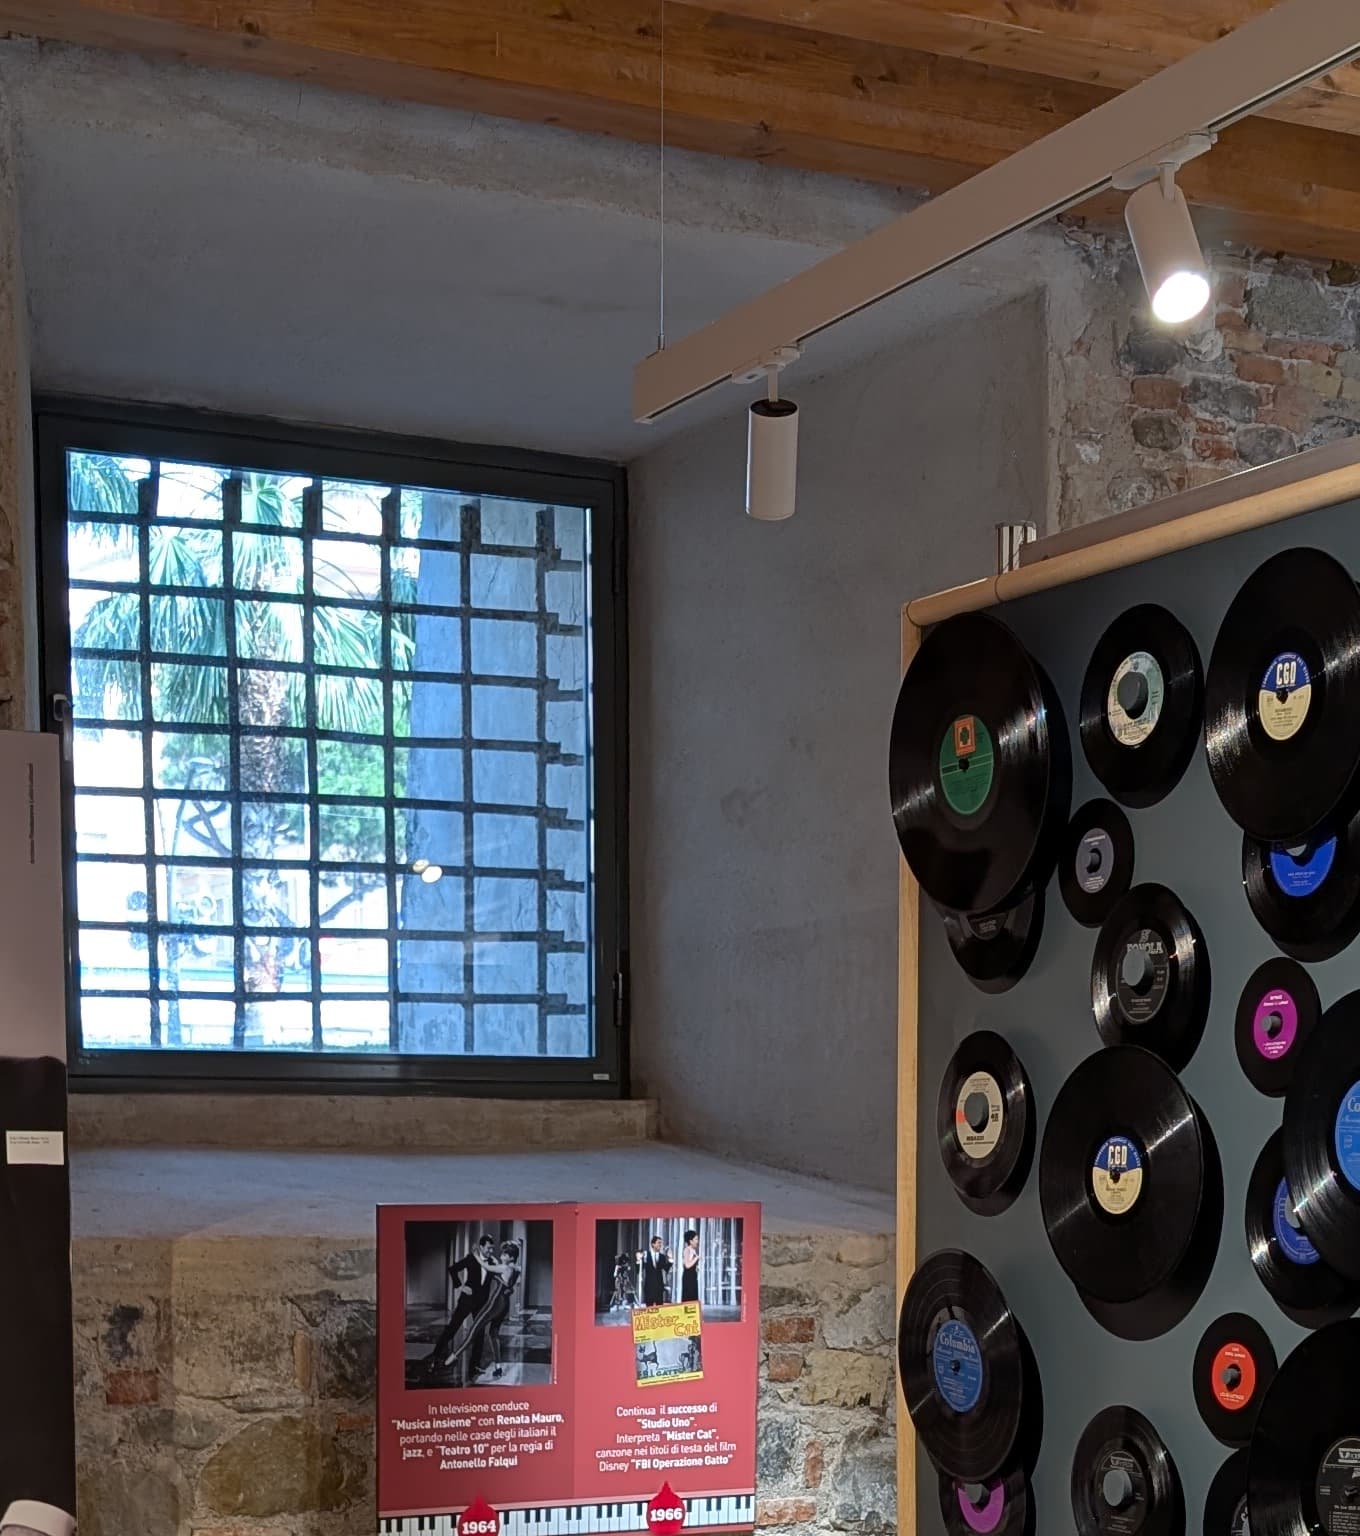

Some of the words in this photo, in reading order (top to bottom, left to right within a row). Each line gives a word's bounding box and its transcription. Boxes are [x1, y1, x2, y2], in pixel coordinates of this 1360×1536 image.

[1276, 661, 1297, 685] CGD
[1109, 1145, 1128, 1165] CGD
[428, 1405, 437, 1413] In
[440, 1403, 489, 1413] televisione
[490, 1401, 529, 1410] conduce
[616, 1406, 655, 1415] Continua
[660, 1405, 665, 1413] il
[709, 1403, 717, 1411] di
[392, 1418, 431, 1430] "Musica
[433, 1416, 477, 1427] insieme"
[497, 1415, 530, 1424] Renata
[637, 1418, 671, 1429] "Studio
[400, 1432, 442, 1445] portando
[444, 1431, 468, 1440] nelle
[493, 1429, 516, 1440] degli
[518, 1427, 548, 1437] italiani
[550, 1427, 556, 1435] il
[616, 1433, 659, 1443] Interpreta
[662, 1430, 695, 1441] "Mister
[436, 1445, 470, 1456] "Teatro
[473, 1444, 489, 1454] 10"
[491, 1445, 506, 1454] per
[509, 1443, 517, 1451] la
[519, 1441, 542, 1452] regia
[544, 1441, 553, 1449] di
[634, 1446, 647, 1455] nei
[649, 1445, 668, 1454] titoli
[670, 1444, 679, 1453] di
[681, 1444, 702, 1452] testa
[703, 1443, 717, 1451] del
[719, 1442, 736, 1450] film
[440, 1458, 486, 1468] Antonello
[488, 1456, 517, 1467] Falqui
[599, 1461, 628, 1471] Disney
[631, 1458, 651, 1470] "FBI
[652, 1457, 703, 1469] Operazione
[704, 1454, 733, 1466] Gatto"
[650, 1507, 683, 1522] 1966
[462, 1520, 497, 1535] 1964
